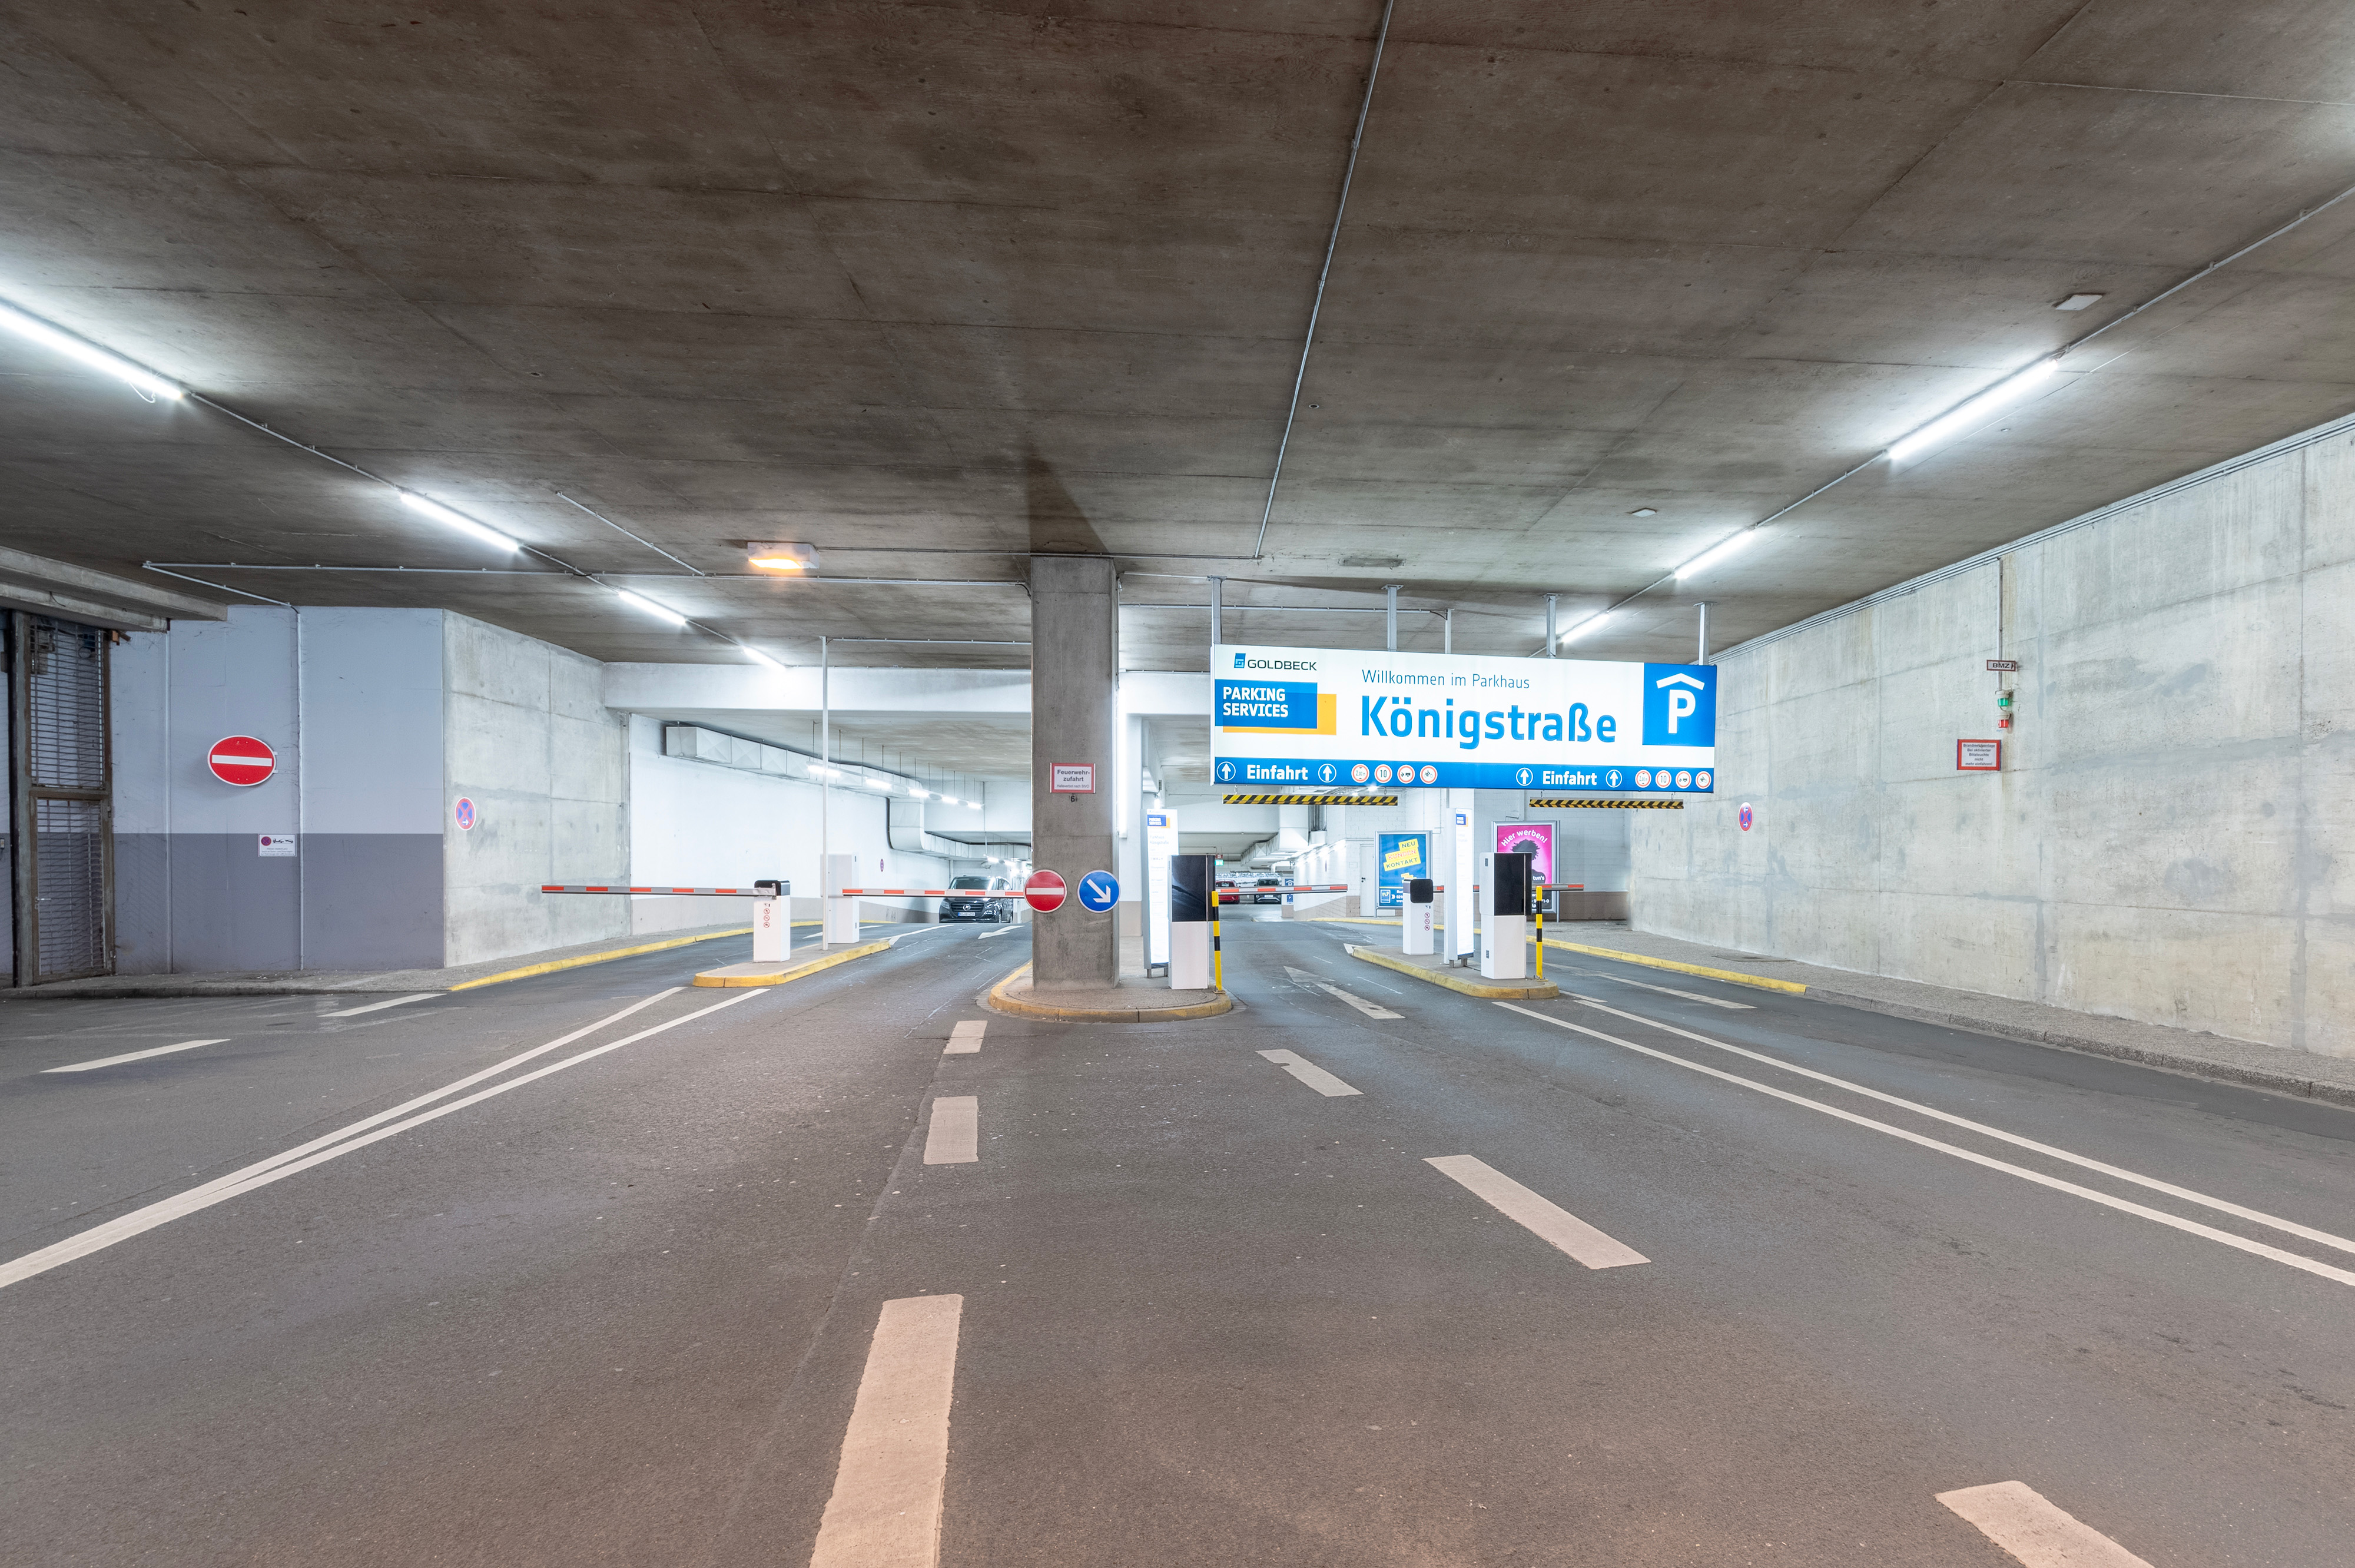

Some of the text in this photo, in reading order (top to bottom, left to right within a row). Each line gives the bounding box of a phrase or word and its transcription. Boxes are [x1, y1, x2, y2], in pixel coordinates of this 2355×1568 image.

[1248, 659, 1317, 671] GOLDBECK
[1362, 669, 1530, 689] Willkommen im Parkhaus
[1223, 687, 1285, 701] PARKING
[1223, 702, 1288, 717] SERVICES
[1668, 689, 1696, 734] P
[1362, 695, 1616, 749] Königstraße
[1247, 765, 1308, 780] Einfahrt
[1543, 770, 1597, 785] Einfahrt
[1501, 830, 1548, 846] Hier werben!
[1388, 849, 1416, 860] KUNDEN
[1386, 857, 1418, 868] KONTAKT
